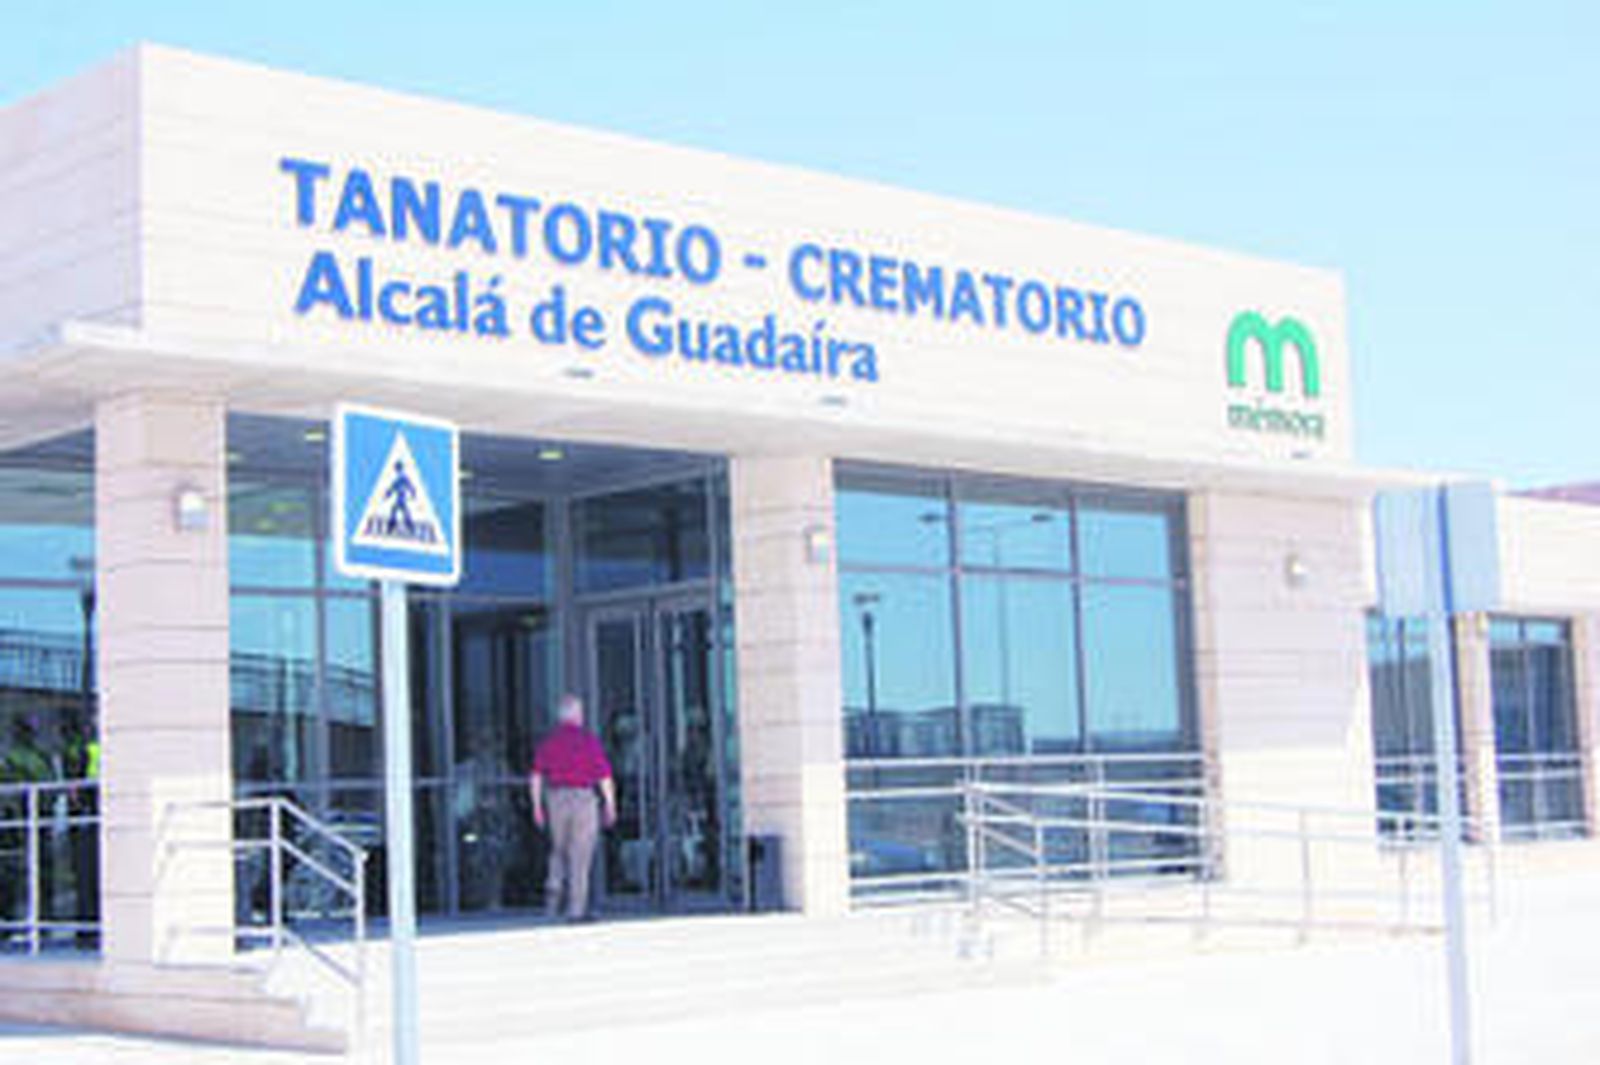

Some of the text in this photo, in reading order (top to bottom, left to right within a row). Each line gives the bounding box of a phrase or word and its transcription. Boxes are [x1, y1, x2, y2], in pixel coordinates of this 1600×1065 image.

[280, 157, 722, 285] TANATORIO
[790, 242, 1147, 347] CREMATORIO
[294, 250, 880, 383] Alcalá de Guadaíra
